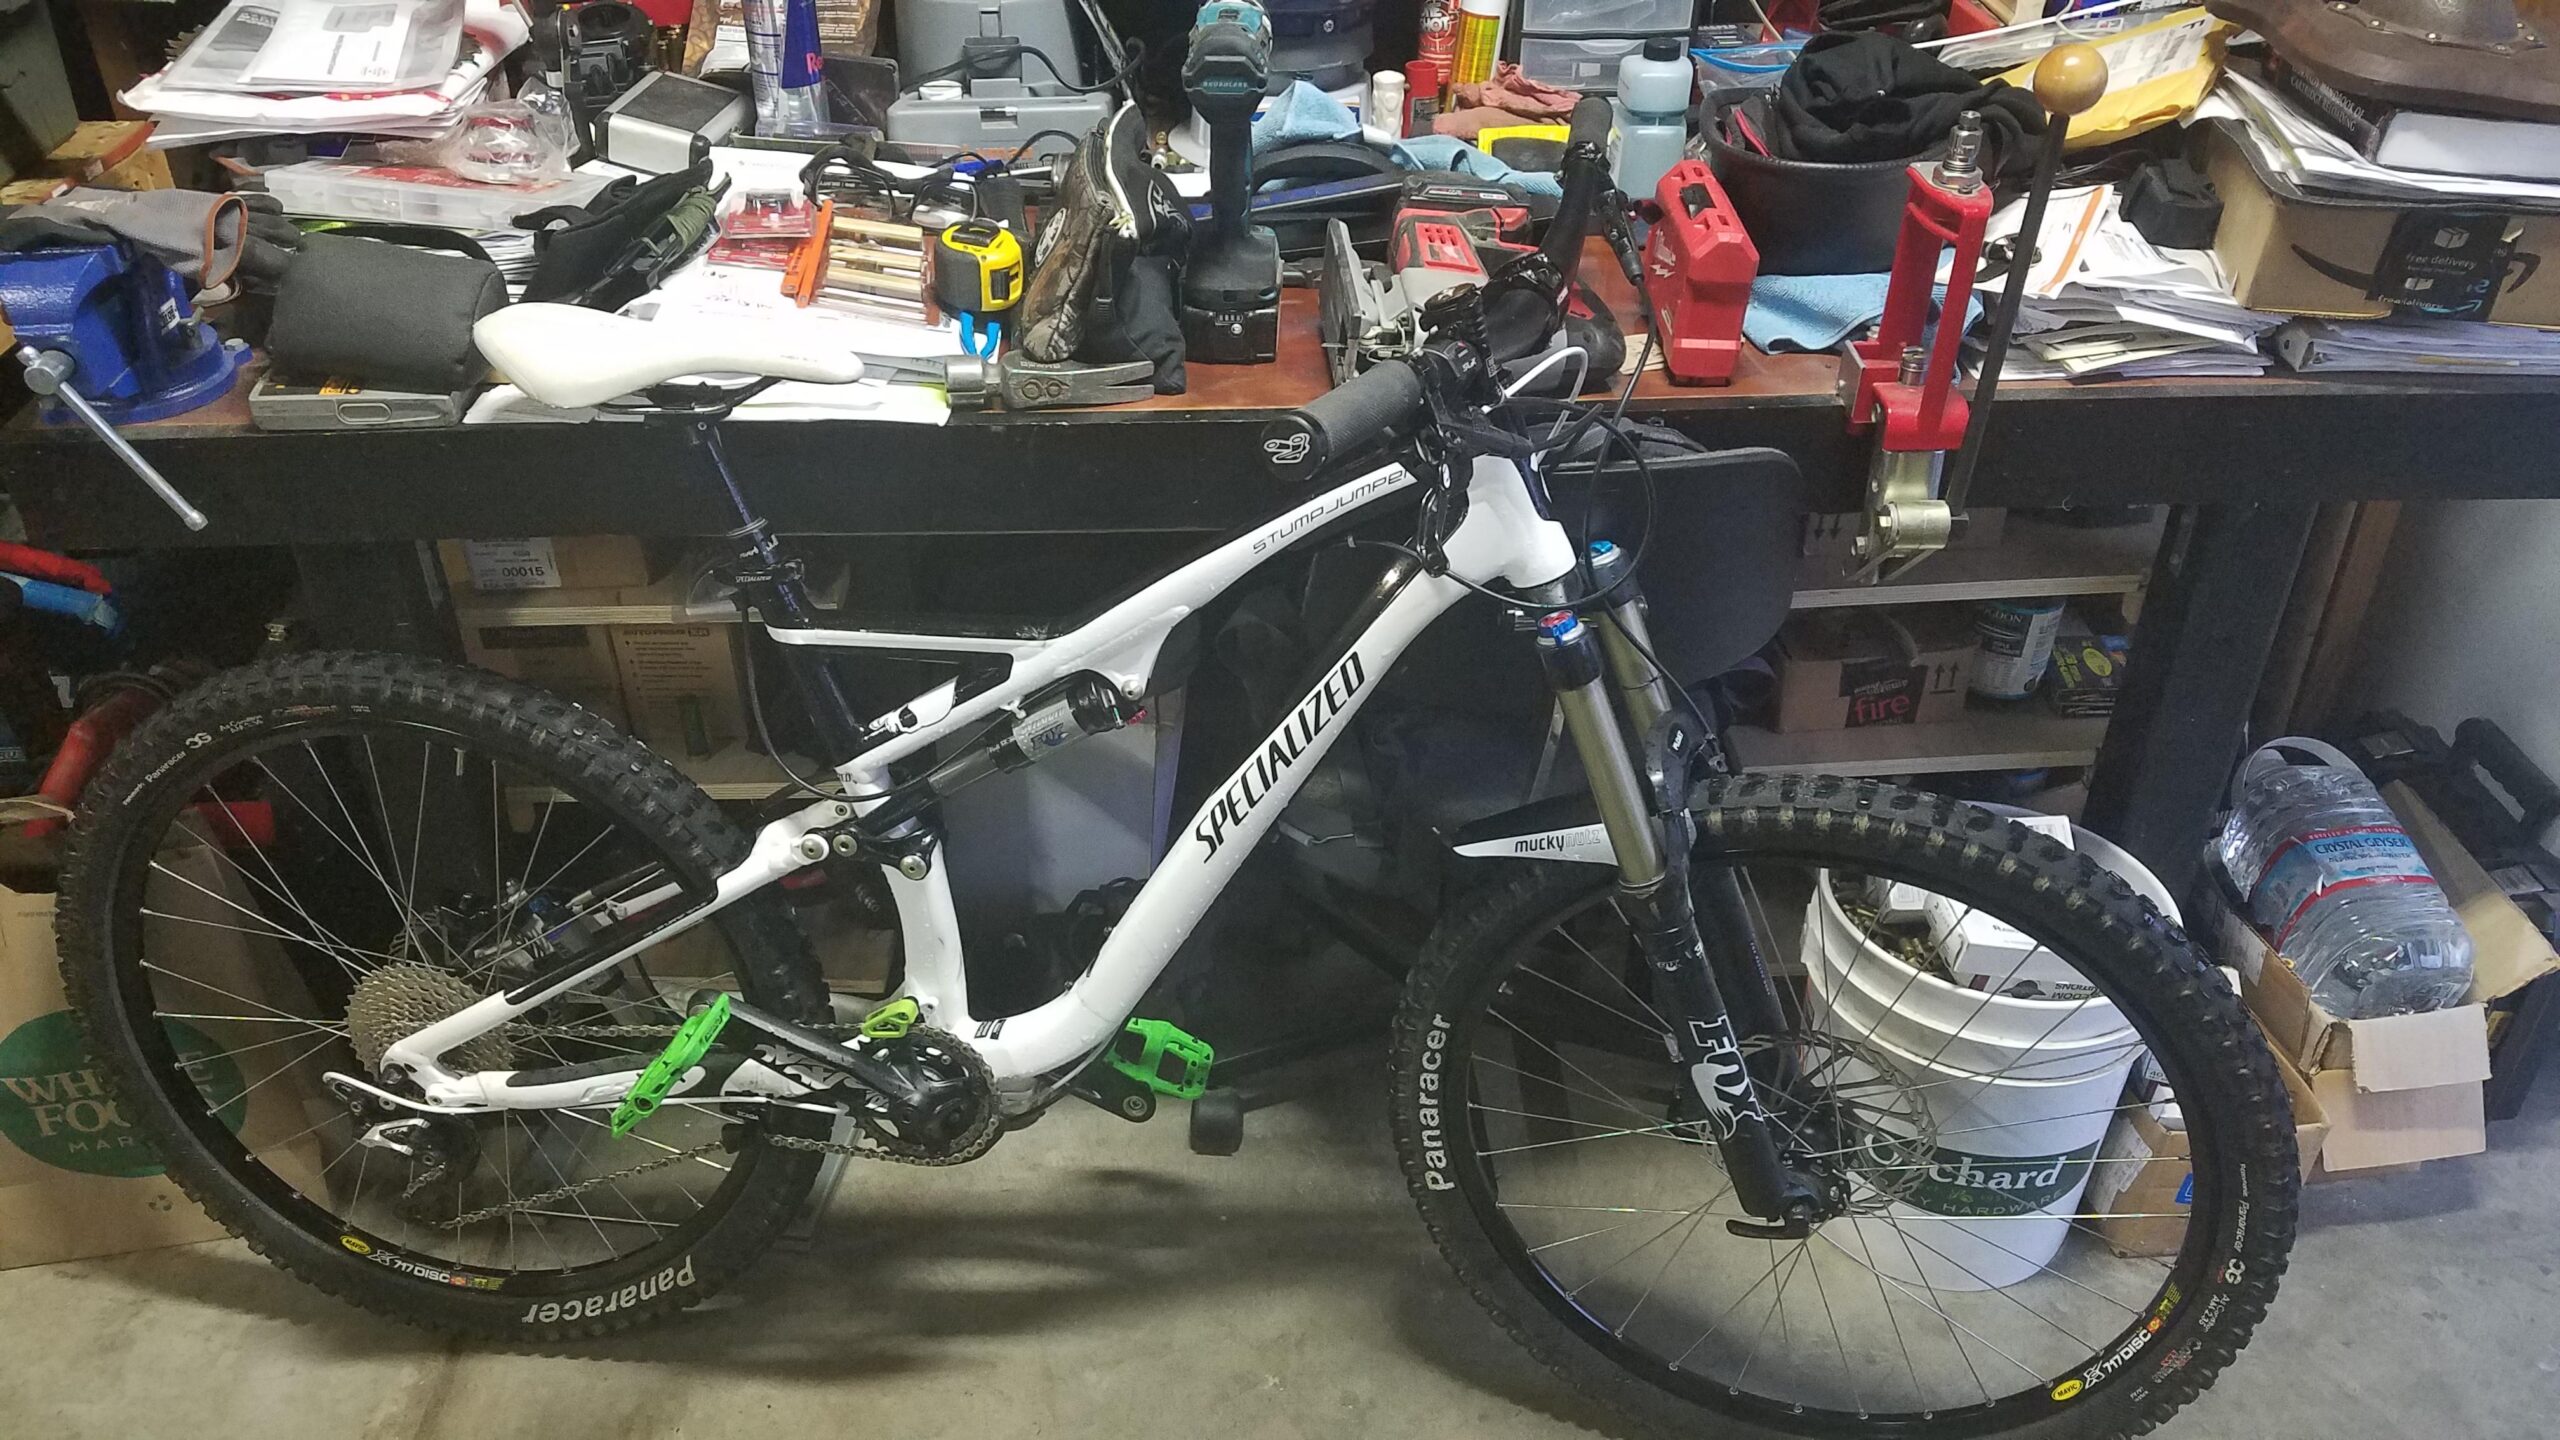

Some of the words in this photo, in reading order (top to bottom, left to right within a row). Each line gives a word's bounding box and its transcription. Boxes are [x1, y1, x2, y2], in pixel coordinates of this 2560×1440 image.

[805, 52, 823, 74] Re
[502, 566, 545, 577] 00015
[1855, 694, 1910, 723] fire
[1195, 651, 1366, 864] SPECIALIZED
[2314, 840, 2366, 855] CRYSTAL
[2365, 836, 2408, 849] GEYSER
[1688, 1014, 1764, 1128] FOX
[1864, 1130, 2068, 1190] Ochard
[1942, 1188, 2064, 1216] HARDWARE
[344, 1238, 367, 1252] MAVIC
[2056, 1382, 2079, 1398] MAVIC
